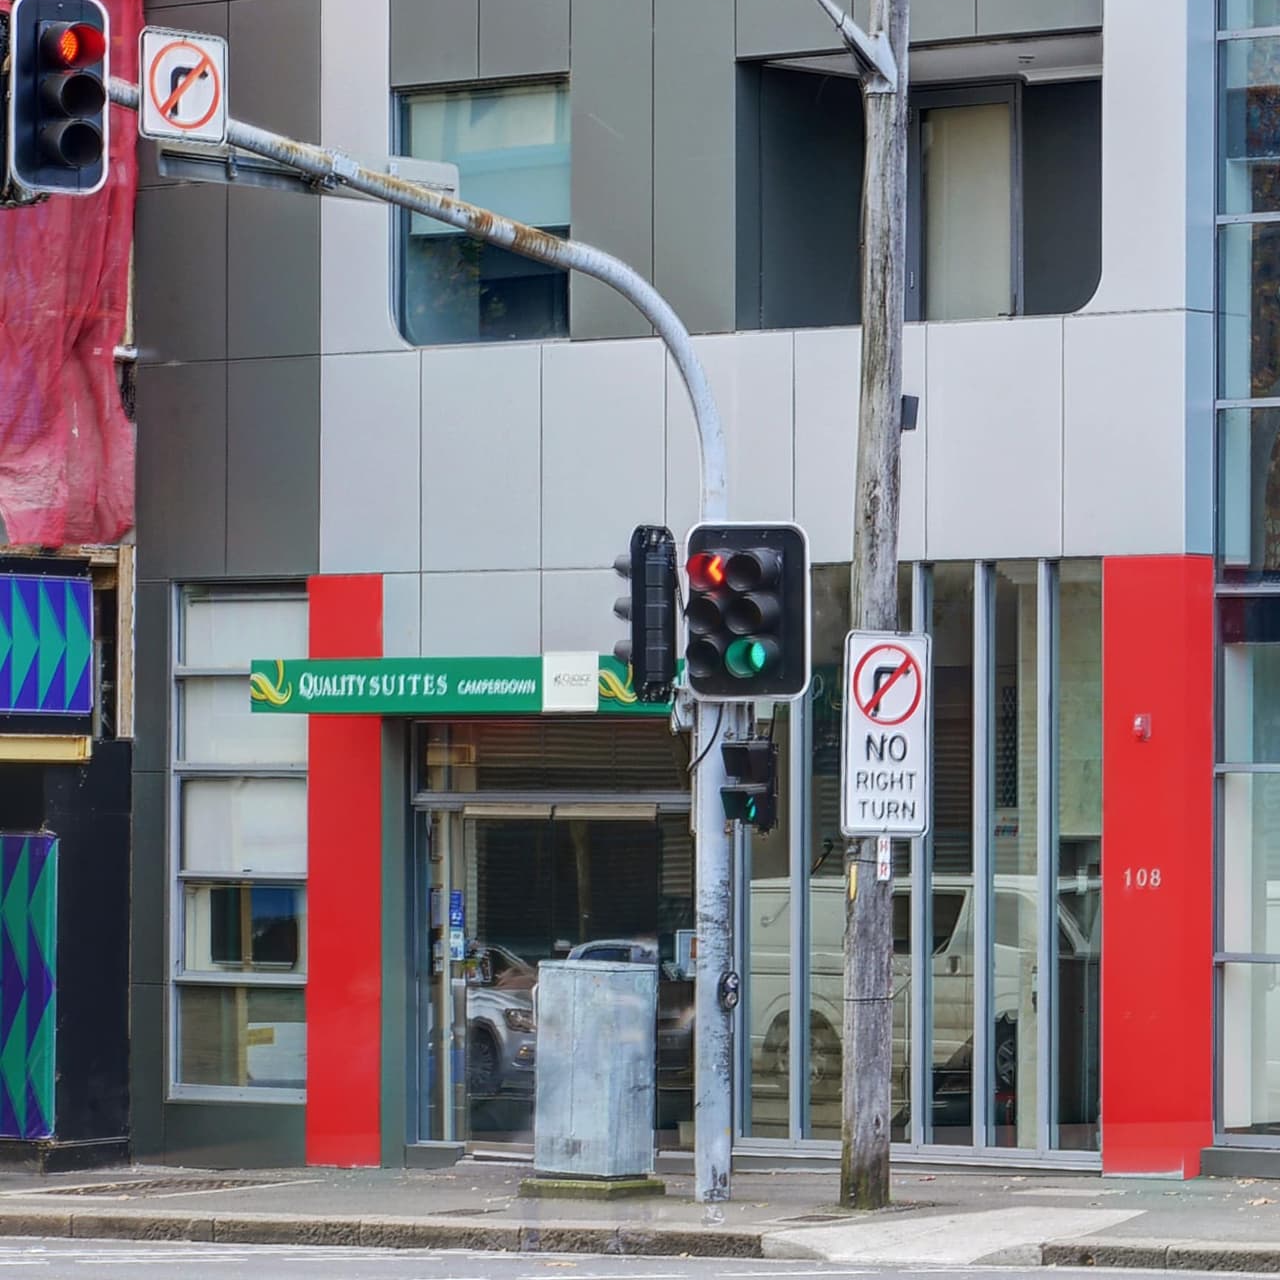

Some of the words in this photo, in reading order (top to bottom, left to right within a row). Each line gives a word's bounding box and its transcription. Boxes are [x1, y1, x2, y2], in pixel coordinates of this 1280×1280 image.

[299, 672, 367, 700] QUALITY
[368, 673, 448, 697] SUITES
[457, 678, 536, 695] CAMPERDOWN
[866, 732, 908, 763] NO
[855, 771, 917, 792] RIGHT
[858, 800, 916, 820] TURN
[1124, 868, 1162, 887] 108
